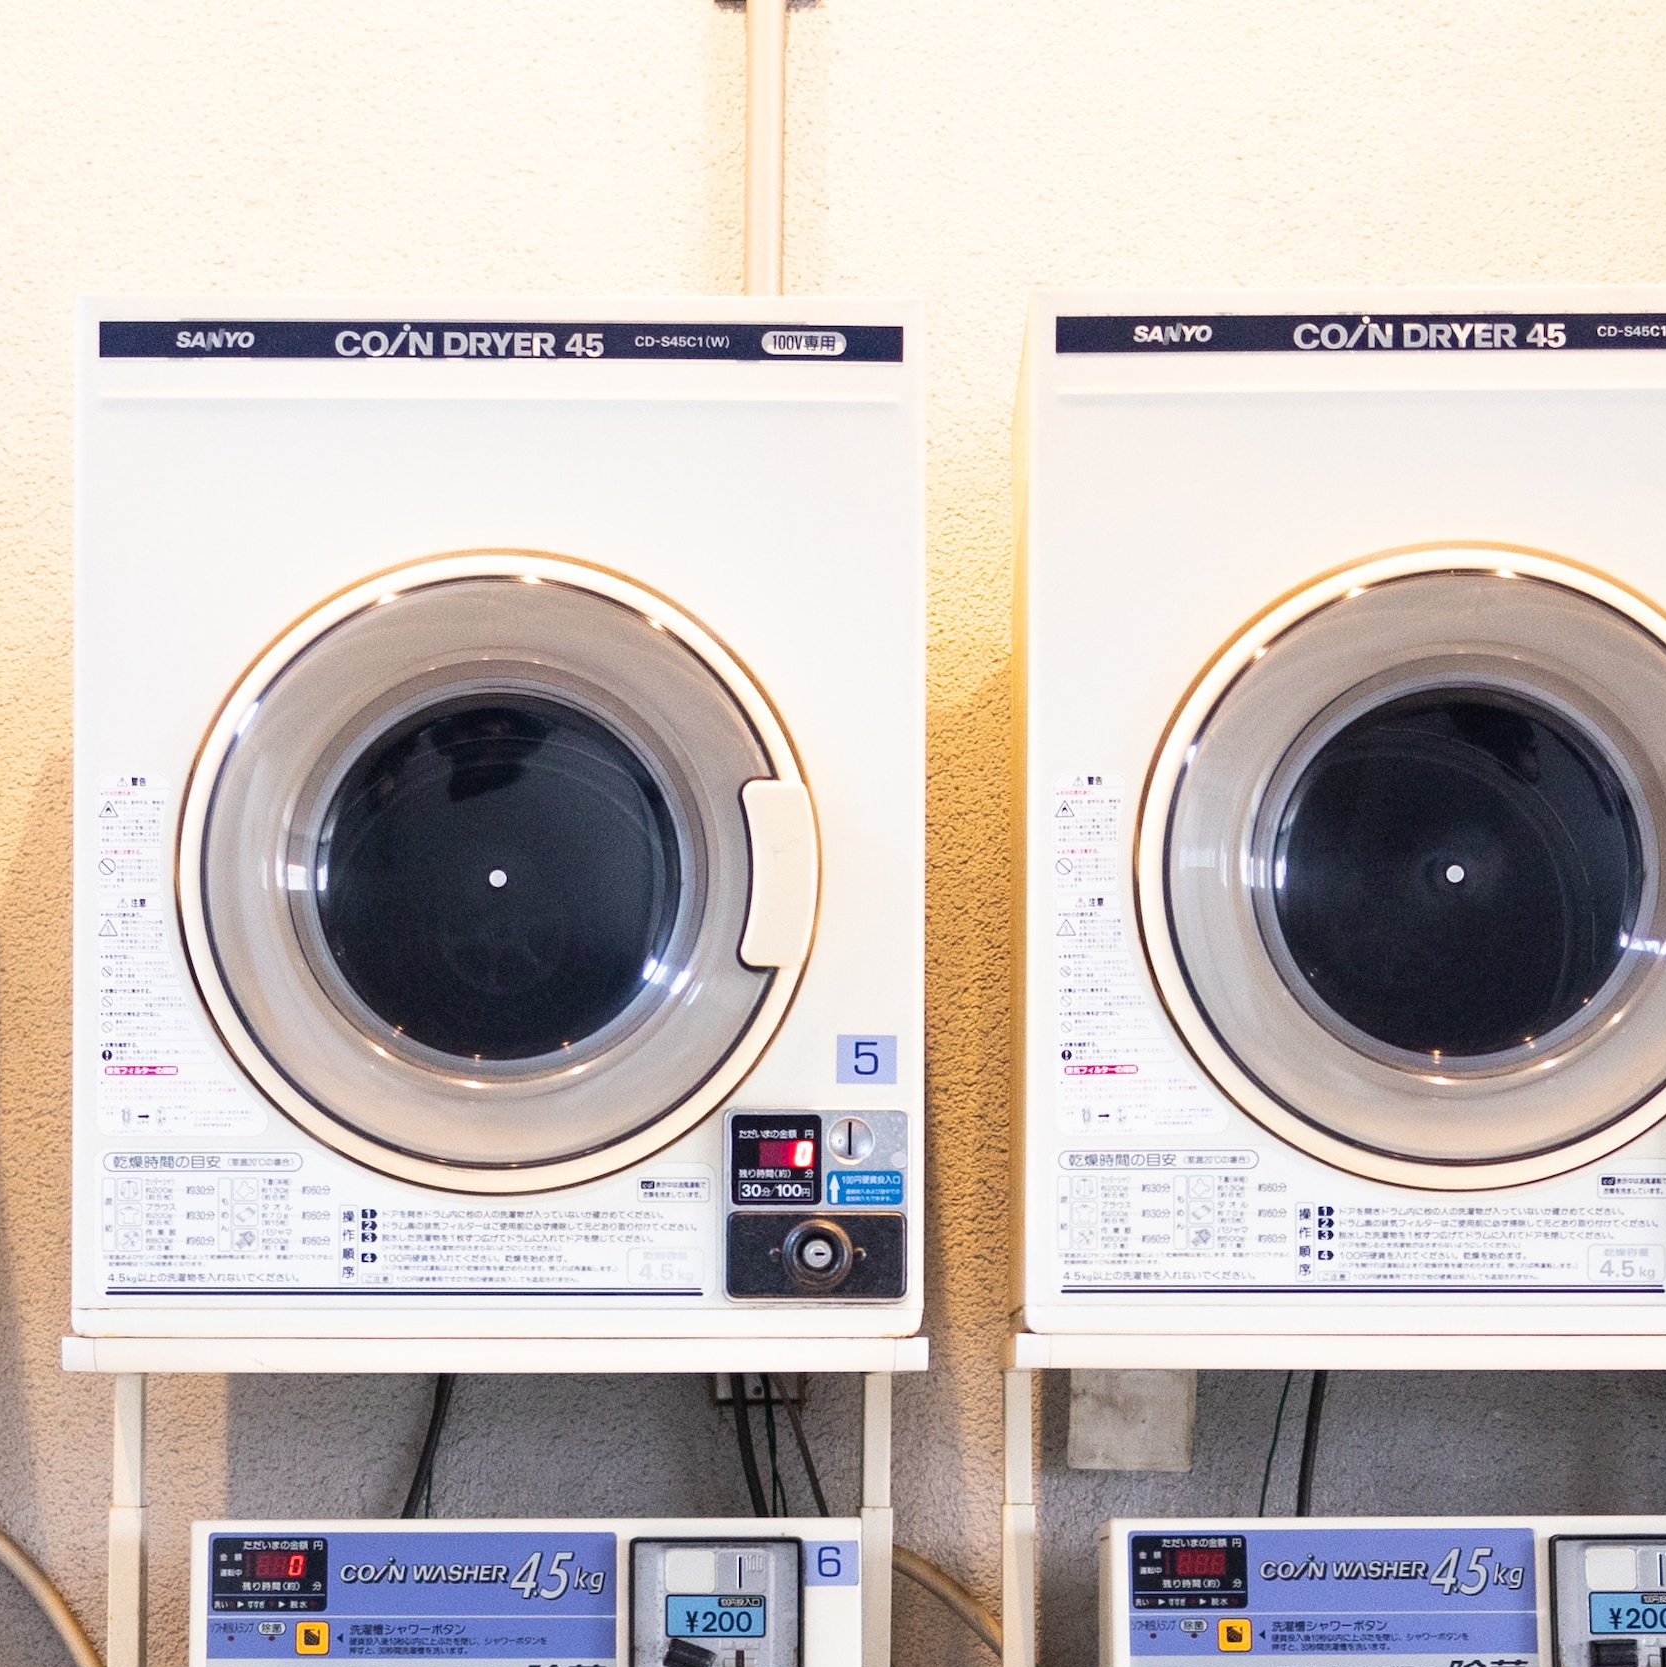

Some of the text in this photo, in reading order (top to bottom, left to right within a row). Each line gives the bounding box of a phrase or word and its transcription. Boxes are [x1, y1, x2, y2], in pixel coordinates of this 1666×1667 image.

[176, 324, 837, 358] SANYO COIN DRYER 45 CD-S45C1(W) 100V専用
[1134, 324, 1212, 342] SANYO
[1294, 316, 1393, 349] COIN
[1403, 323, 1516, 347] DRYER
[1527, 324, 1566, 348] 45
[854, 1041, 879, 1076] 5
[739, 1129, 814, 1139] ただいまの金額 円
[113, 1156, 221, 1168] 乾燥時間の目安
[794, 1141, 813, 1167] 0
[1068, 1154, 1176, 1167] 乾燥時間の目安
[804, 1169, 813, 1178] 分
[1599, 1261, 1655, 1279] 4.5 kg
[243, 1541, 323, 1550] ただいまの金額 円
[1162, 1538, 1242, 1548] ただいまの金額 円
[288, 1555, 304, 1576] 0
[817, 1546, 842, 1577] 6
[339, 1552, 606, 1600] COIN WASHER 4.5 kg
[1258, 1547, 1525, 1596] COIN WASHER 4.5 kg
[313, 1582, 321, 1591] 分
[1233, 1579, 1242, 1588] 分
[686, 1611, 752, 1632] ¥200
